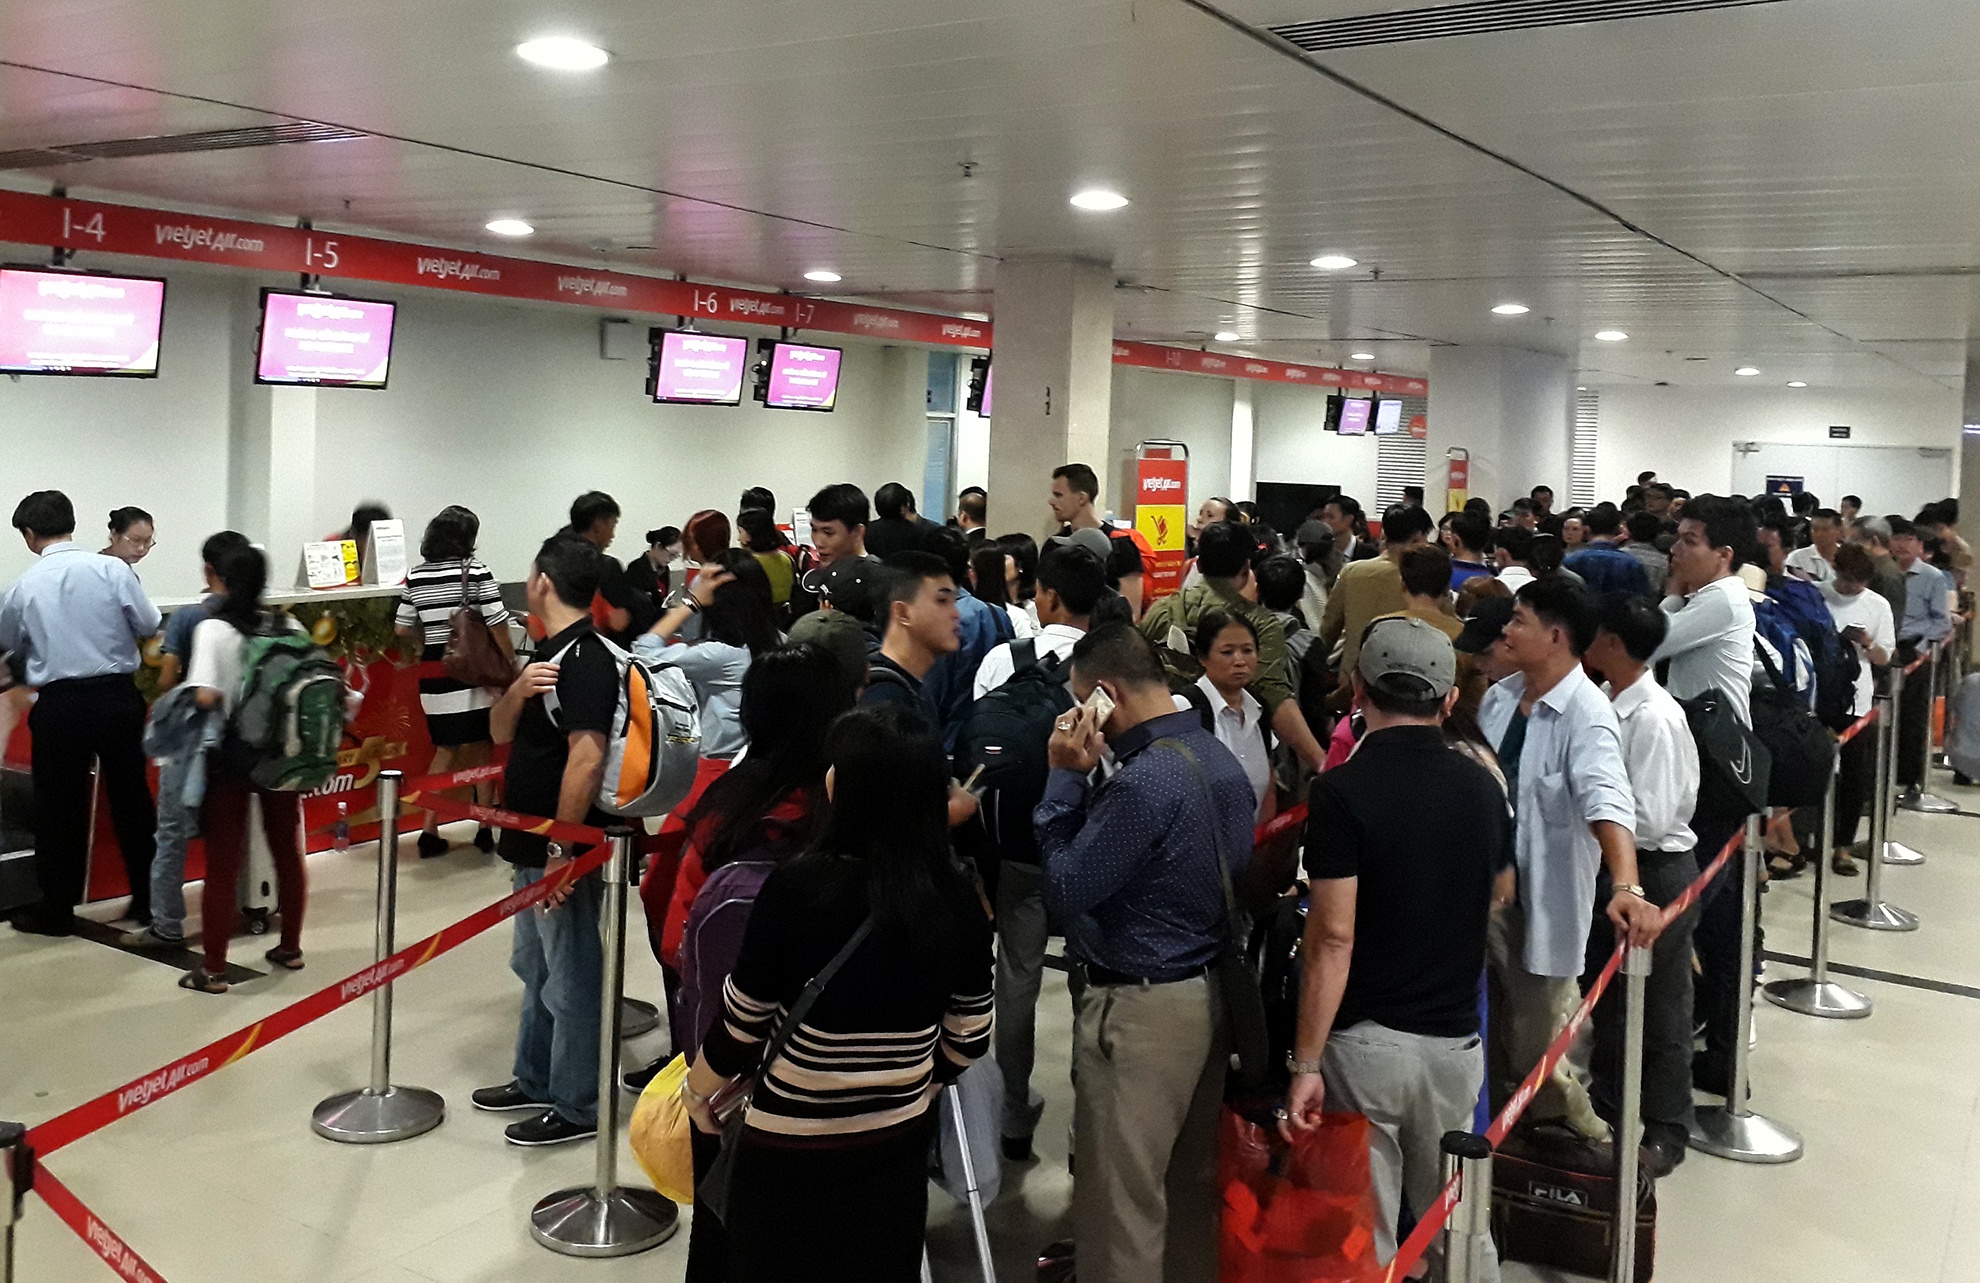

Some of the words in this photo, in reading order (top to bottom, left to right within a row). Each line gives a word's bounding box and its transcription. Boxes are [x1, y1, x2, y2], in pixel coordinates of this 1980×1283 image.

[63, 207, 106, 243] I-4
[305, 237, 339, 269] I-5
[694, 289, 718, 314] I-6
[795, 303, 815, 324] I-7
[1534, 1187, 1582, 1205] FILA
